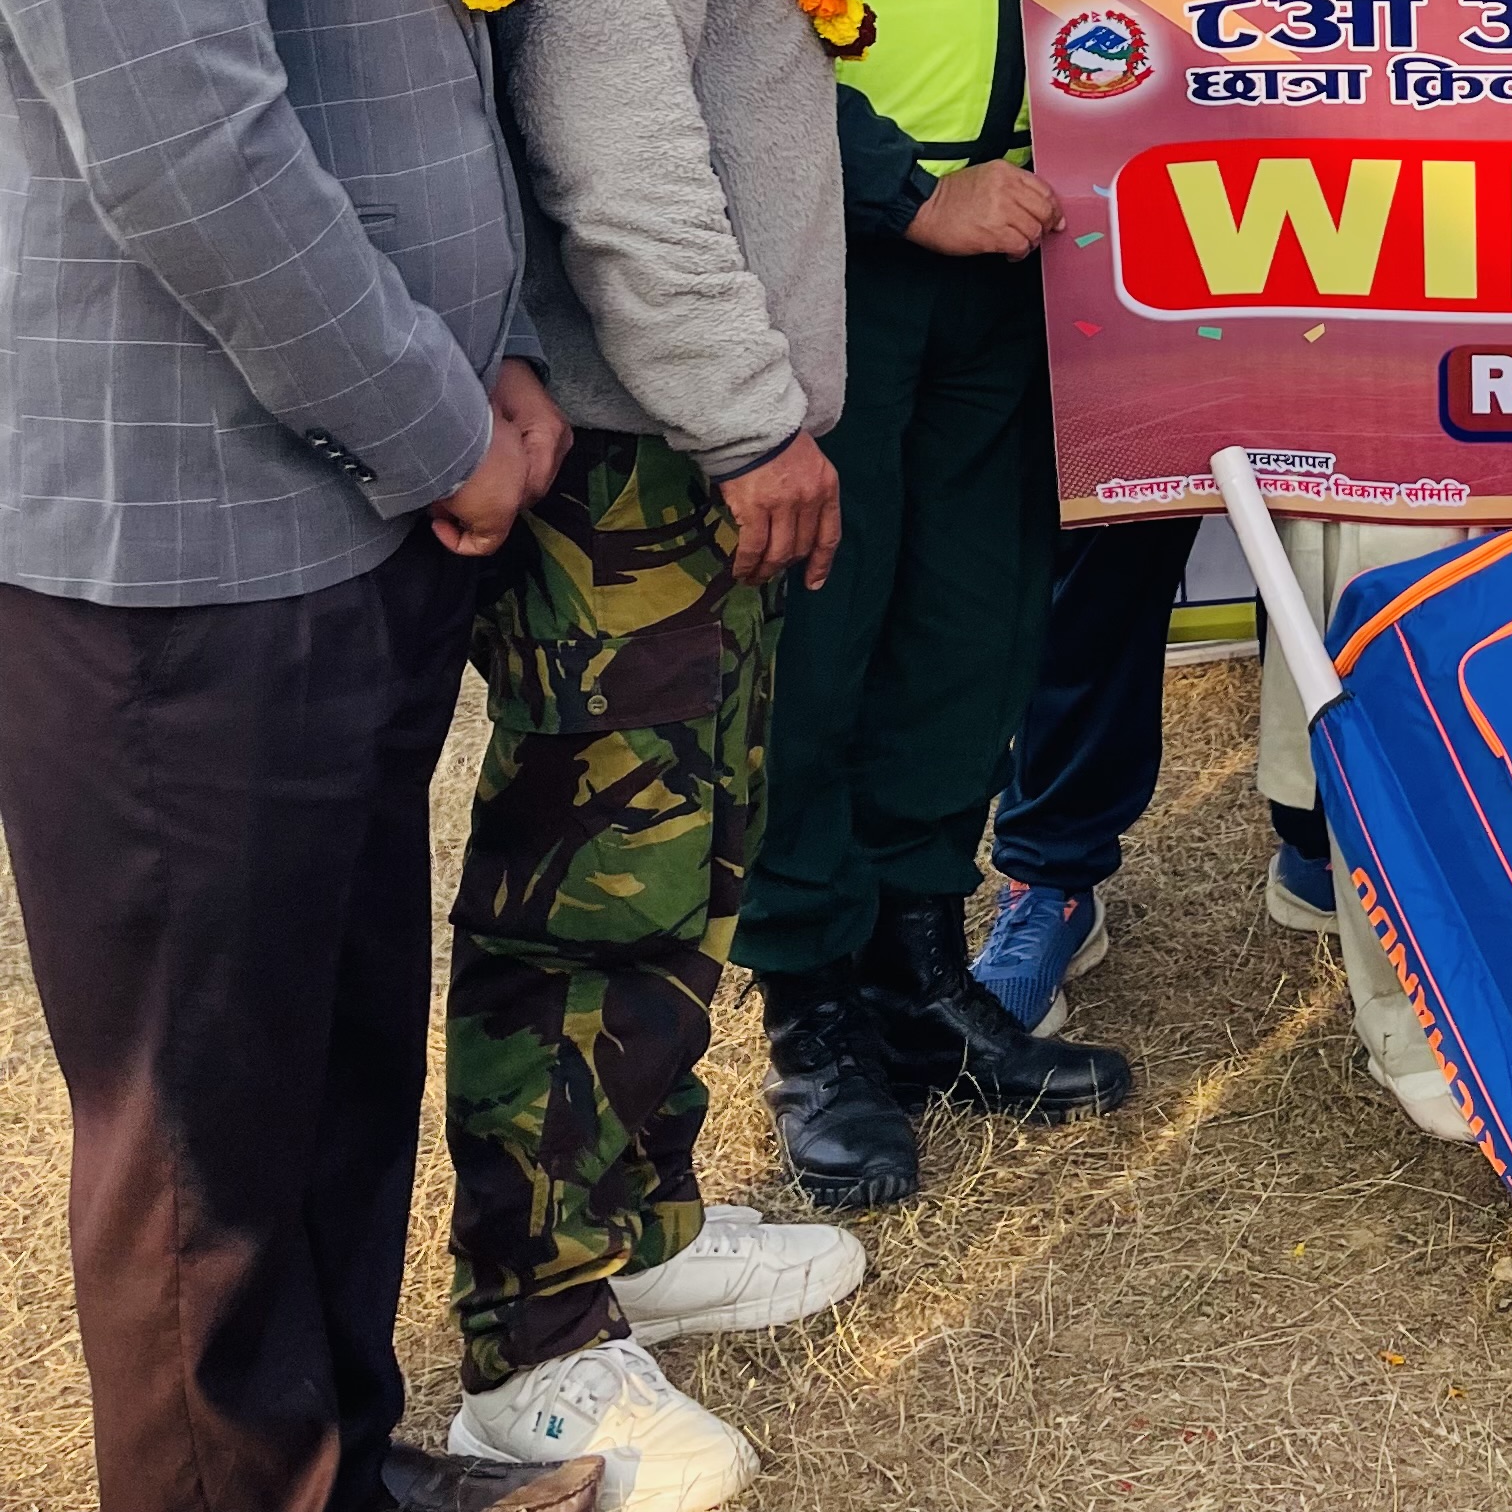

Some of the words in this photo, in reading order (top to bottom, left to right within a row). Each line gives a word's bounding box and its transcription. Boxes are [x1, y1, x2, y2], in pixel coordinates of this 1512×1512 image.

[1190, 68, 1368, 103] छात्रा
[1101, 481, 1182, 500] कोहलपुर
[1334, 478, 1395, 502] विकास
[1405, 483, 1465, 502] समिति
